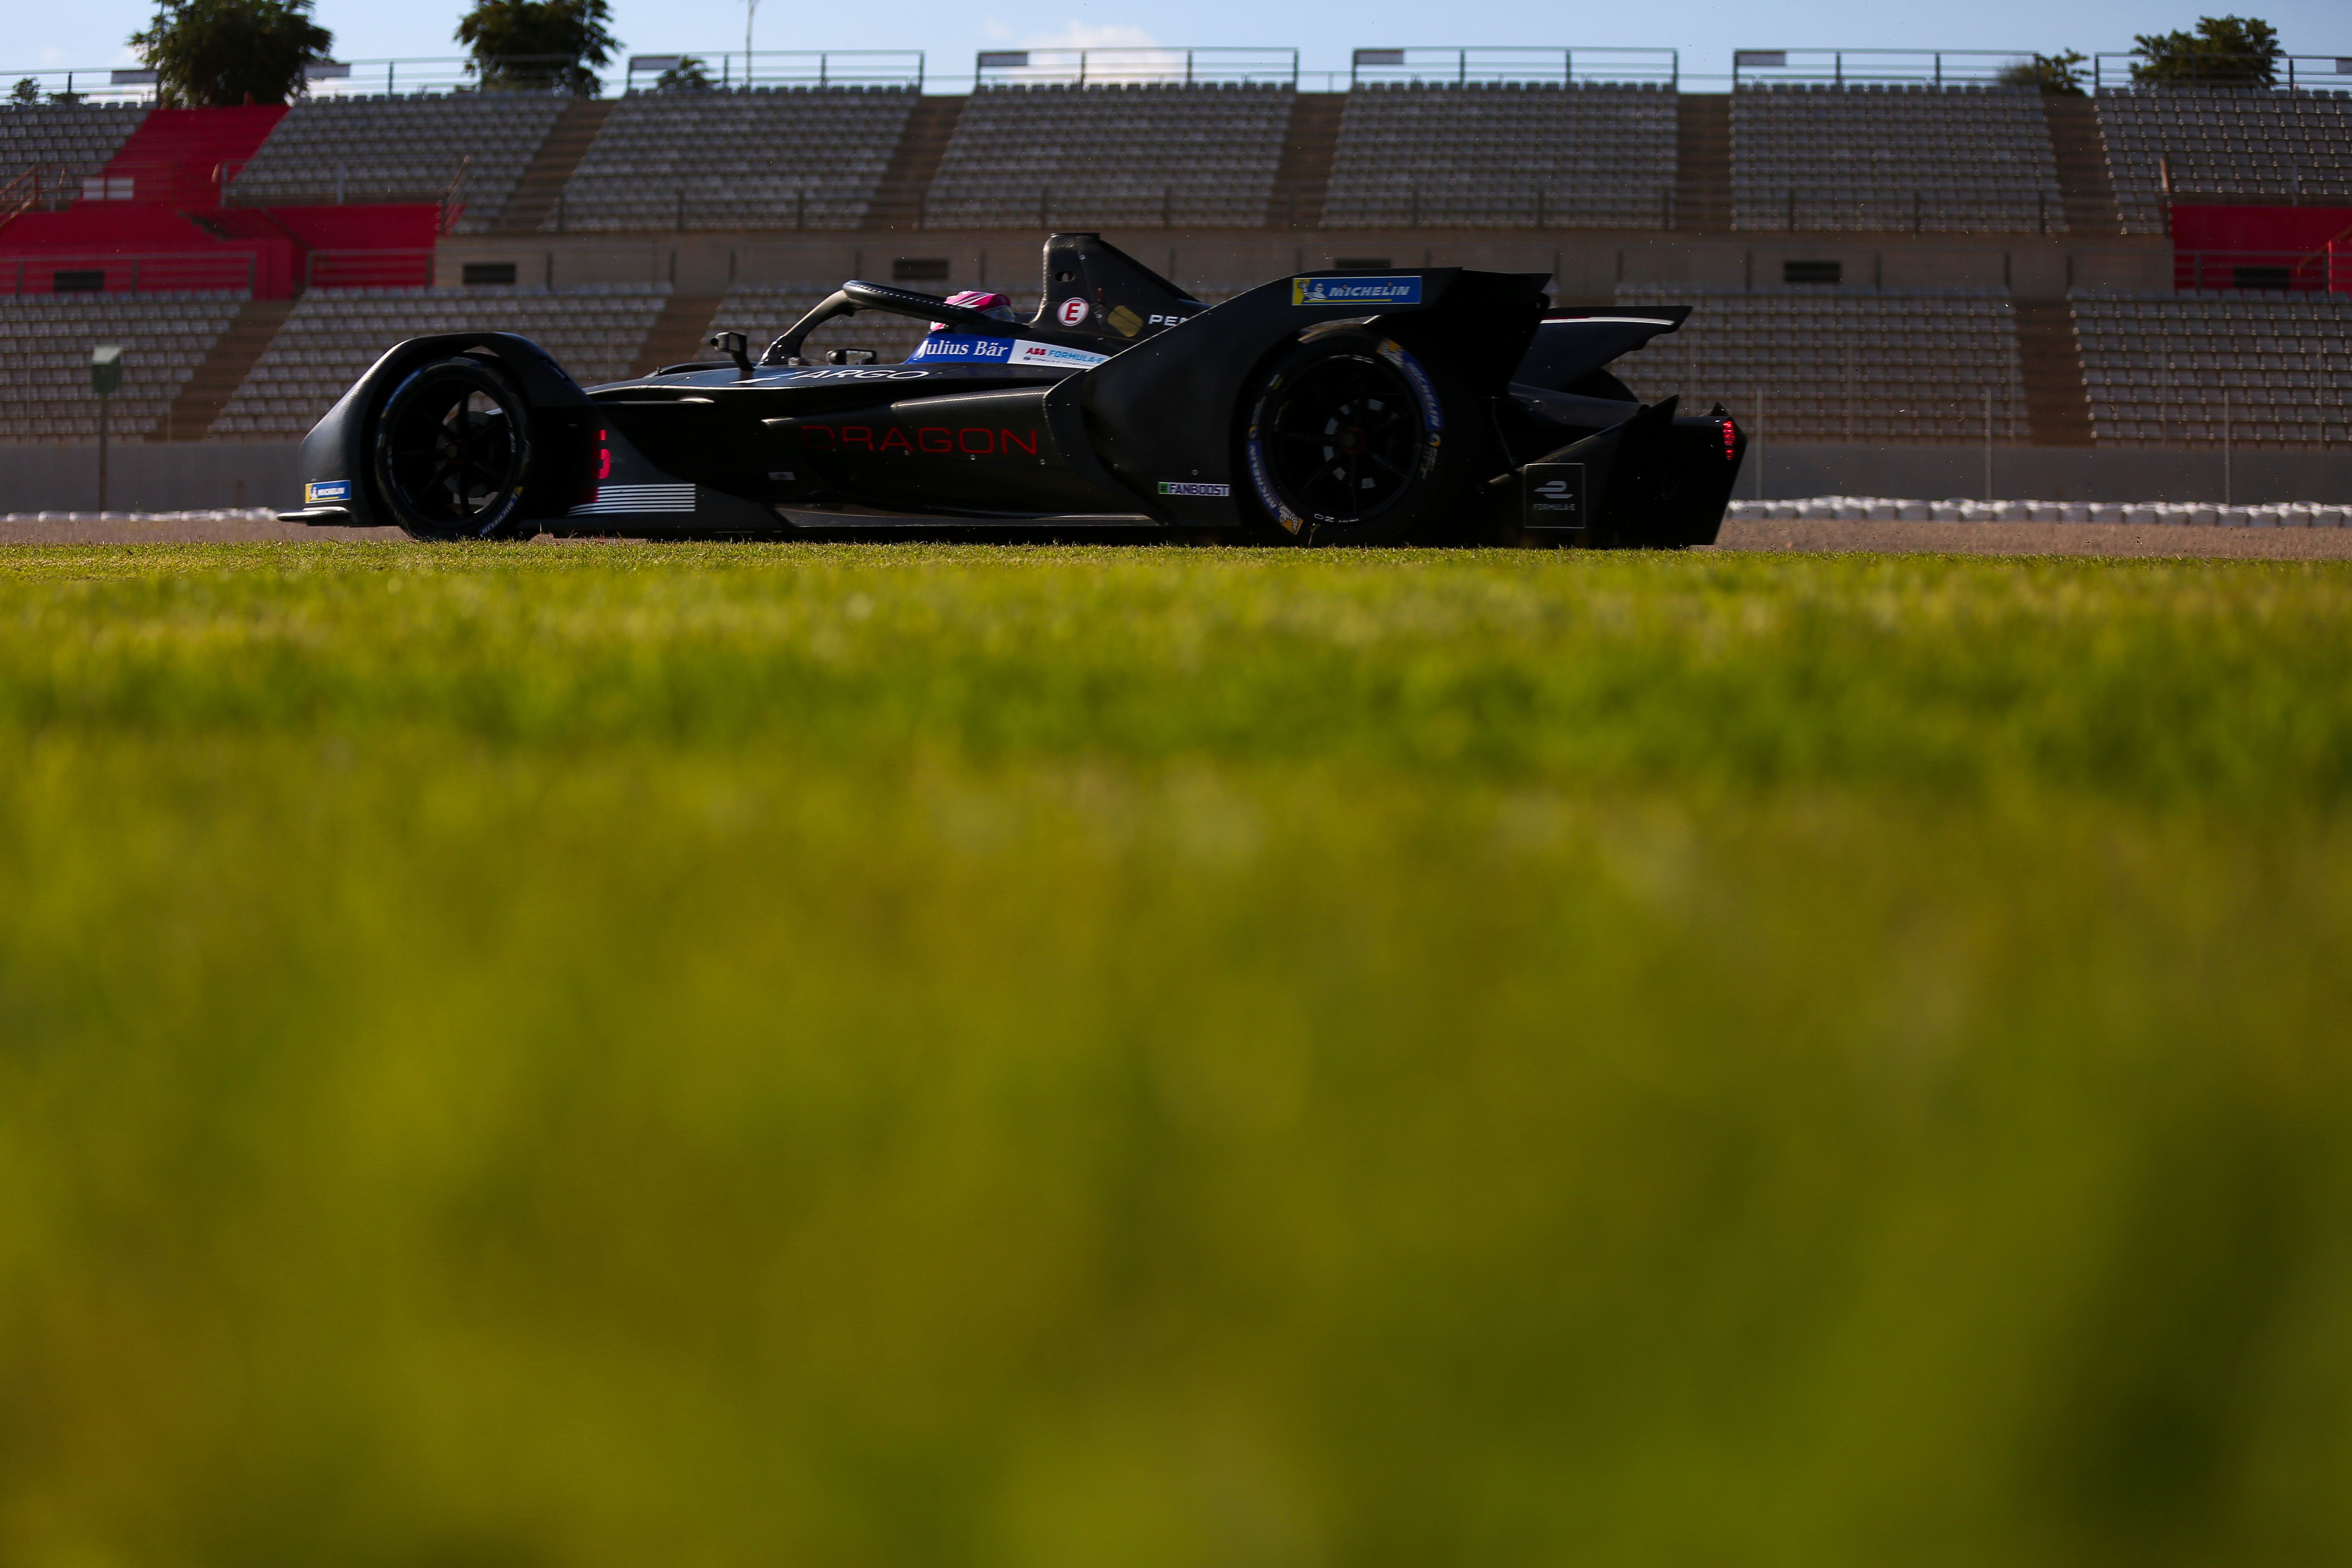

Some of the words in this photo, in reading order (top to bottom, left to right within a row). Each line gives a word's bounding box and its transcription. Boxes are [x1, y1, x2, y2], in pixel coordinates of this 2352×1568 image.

[1328, 286, 1411, 296] MICHELIN
[1065, 303, 1081, 321] E
[917, 340, 970, 359] Julius
[972, 341, 1009, 356] Bär
[1025, 347, 1047, 356] ABB
[801, 425, 1038, 454] DRAGON
[589, 429, 612, 479] 6
[481, 500, 514, 535] MICHELIN
